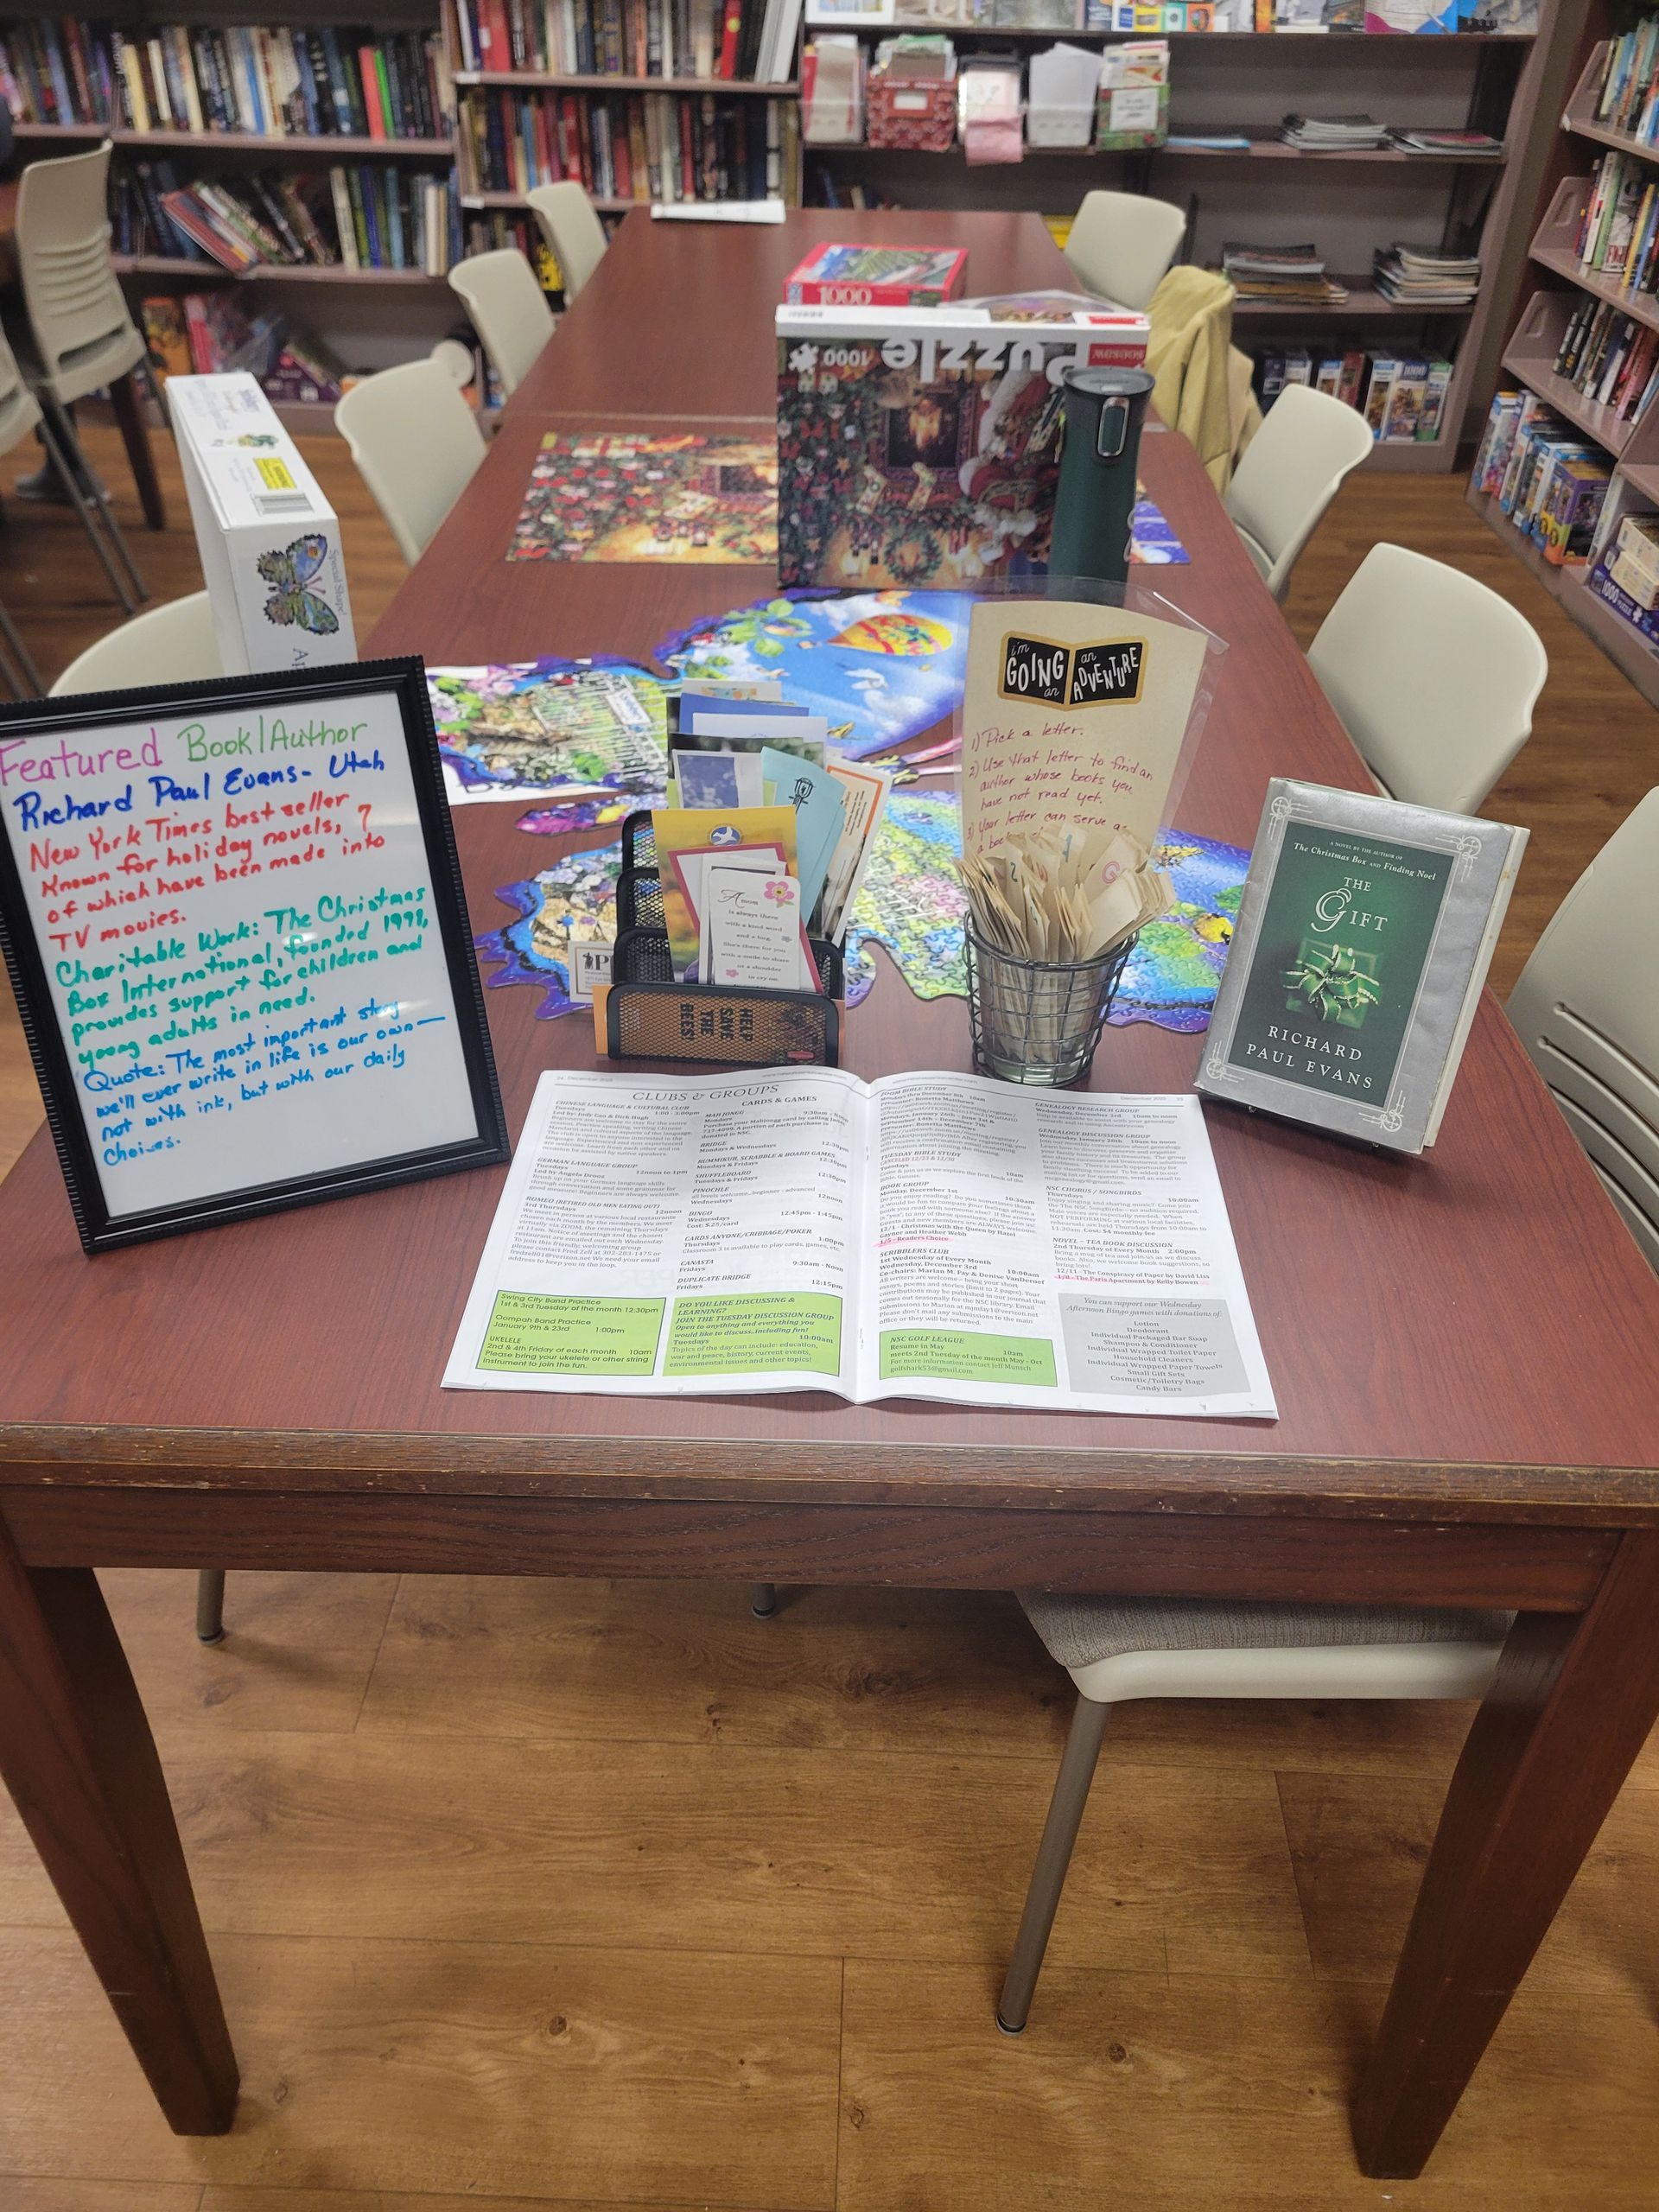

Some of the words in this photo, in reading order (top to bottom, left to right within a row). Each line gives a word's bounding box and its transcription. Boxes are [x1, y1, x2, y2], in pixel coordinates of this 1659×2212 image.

[817, 286, 872, 305] 1000
[823, 349, 869, 366] 1000
[881, 335, 1085, 385] Puzzle
[1601, 580, 1620, 603] 1000
[1005, 650, 1065, 691] GOING
[1074, 647, 1140, 701] ADVENTURE
[1081, 651, 1097, 664] an
[982, 727, 1015, 747] Pick
[1042, 722, 1084, 736] letter.
[0, 728, 162, 785] Featured
[982, 757, 1004, 772] Use
[1008, 750, 1039, 766] that
[1046, 748, 1084, 765] letter
[1090, 753, 1104, 767] to
[1111, 755, 1140, 775] find
[1140, 767, 1154, 782] an
[13, 785, 132, 831] Richard
[148, 772, 210, 808] Paul
[328, 749, 385, 779] Utah
[980, 773, 1015, 792] author
[1025, 768, 1063, 783] whose
[1071, 767, 1107, 787] books
[1112, 779, 1135, 795] you
[980, 795, 1003, 812] have
[1009, 788, 1032, 803] not
[1038, 786, 1070, 801] read
[1077, 792, 1103, 808] yet.
[29, 837, 80, 873] New
[88, 825, 142, 861] York
[145, 810, 213, 843] Times
[226, 801, 275, 829] best
[1006, 810, 1038, 825] letter
[1044, 813, 1067, 823] can
[1073, 816, 1107, 828] serve
[41, 874, 111, 899] Known
[116, 852, 159, 875] for
[167, 834, 252, 865] holiday
[264, 816, 341, 846] novels,
[358, 803, 372, 833] 7
[1294, 842, 1310, 852] The
[1311, 846, 1350, 861] Christmas
[1352, 855, 1368, 865] Box
[1383, 861, 1415, 877] Finding
[1417, 868, 1437, 880] Noel
[47, 899, 79, 925] of
[86, 880, 150, 913] which
[156, 876, 206, 896] have
[213, 862, 262, 883] been
[270, 842, 326, 870] made
[342, 832, 386, 856] into
[1344, 876, 1373, 892] THE
[1311, 887, 1389, 932] GIFT
[48, 924, 91, 952] TV
[100, 908, 187, 942] movies.
[55, 938, 186, 988] Charitable
[198, 920, 259, 952] Work:
[264, 906, 312, 935] The
[317, 887, 426, 923] Christmas
[67, 989, 110, 1018] Box
[283, 918, 370, 961] founded
[168, 975, 251, 1014] support
[258, 969, 293, 991] for
[297, 946, 379, 980] children
[386, 933, 422, 956] and
[78, 1040, 140, 1071] young
[148, 1014, 218, 1046] adults
[231, 1004, 251, 1022] in
[259, 985, 315, 1014] need.
[680, 1002, 695, 1041] BEES
[701, 1009, 715, 1037] THE
[719, 1007, 734, 1039] SAVE
[740, 1007, 753, 1042] HELP
[83, 1062, 166, 1092] Quote:
[165, 1048, 206, 1074] The
[213, 1031, 257, 1064] most
[264, 1006, 346, 1047] important
[1268, 1025, 1363, 1061] RICHARD
[96, 1093, 136, 1118] we'll
[142, 1082, 181, 1102] ever
[189, 1063, 237, 1090] write
[245, 1059, 262, 1074] in
[270, 1045, 301, 1068] life
[308, 1042, 329, 1057] is
[337, 1032, 369, 1051] our
[1246, 1043, 1295, 1067] PAUL
[1306, 1059, 1373, 1089] EVANS
[101, 1117, 133, 1142] not
[145, 1103, 187, 1127] with
[196, 1094, 232, 1113] ink,
[240, 1079, 269, 1101] but
[276, 1068, 315, 1090] with
[324, 1063, 354, 1079] our
[363, 1043, 406, 1069] daily
[632, 1091, 689, 1102] CLUBS
[692, 1091, 706, 1101] &
[709, 1084, 780, 1100] GROUPS
[741, 1097, 774, 1107] CARDS
[500, 1293, 526, 1303] Swing
[495, 1314, 533, 1325] Oompah
[489, 1335, 523, 1344] UKELELE
[931, 1336, 966, 1344] LEAGUE
[1135, 1383, 1162, 1392] Candy
